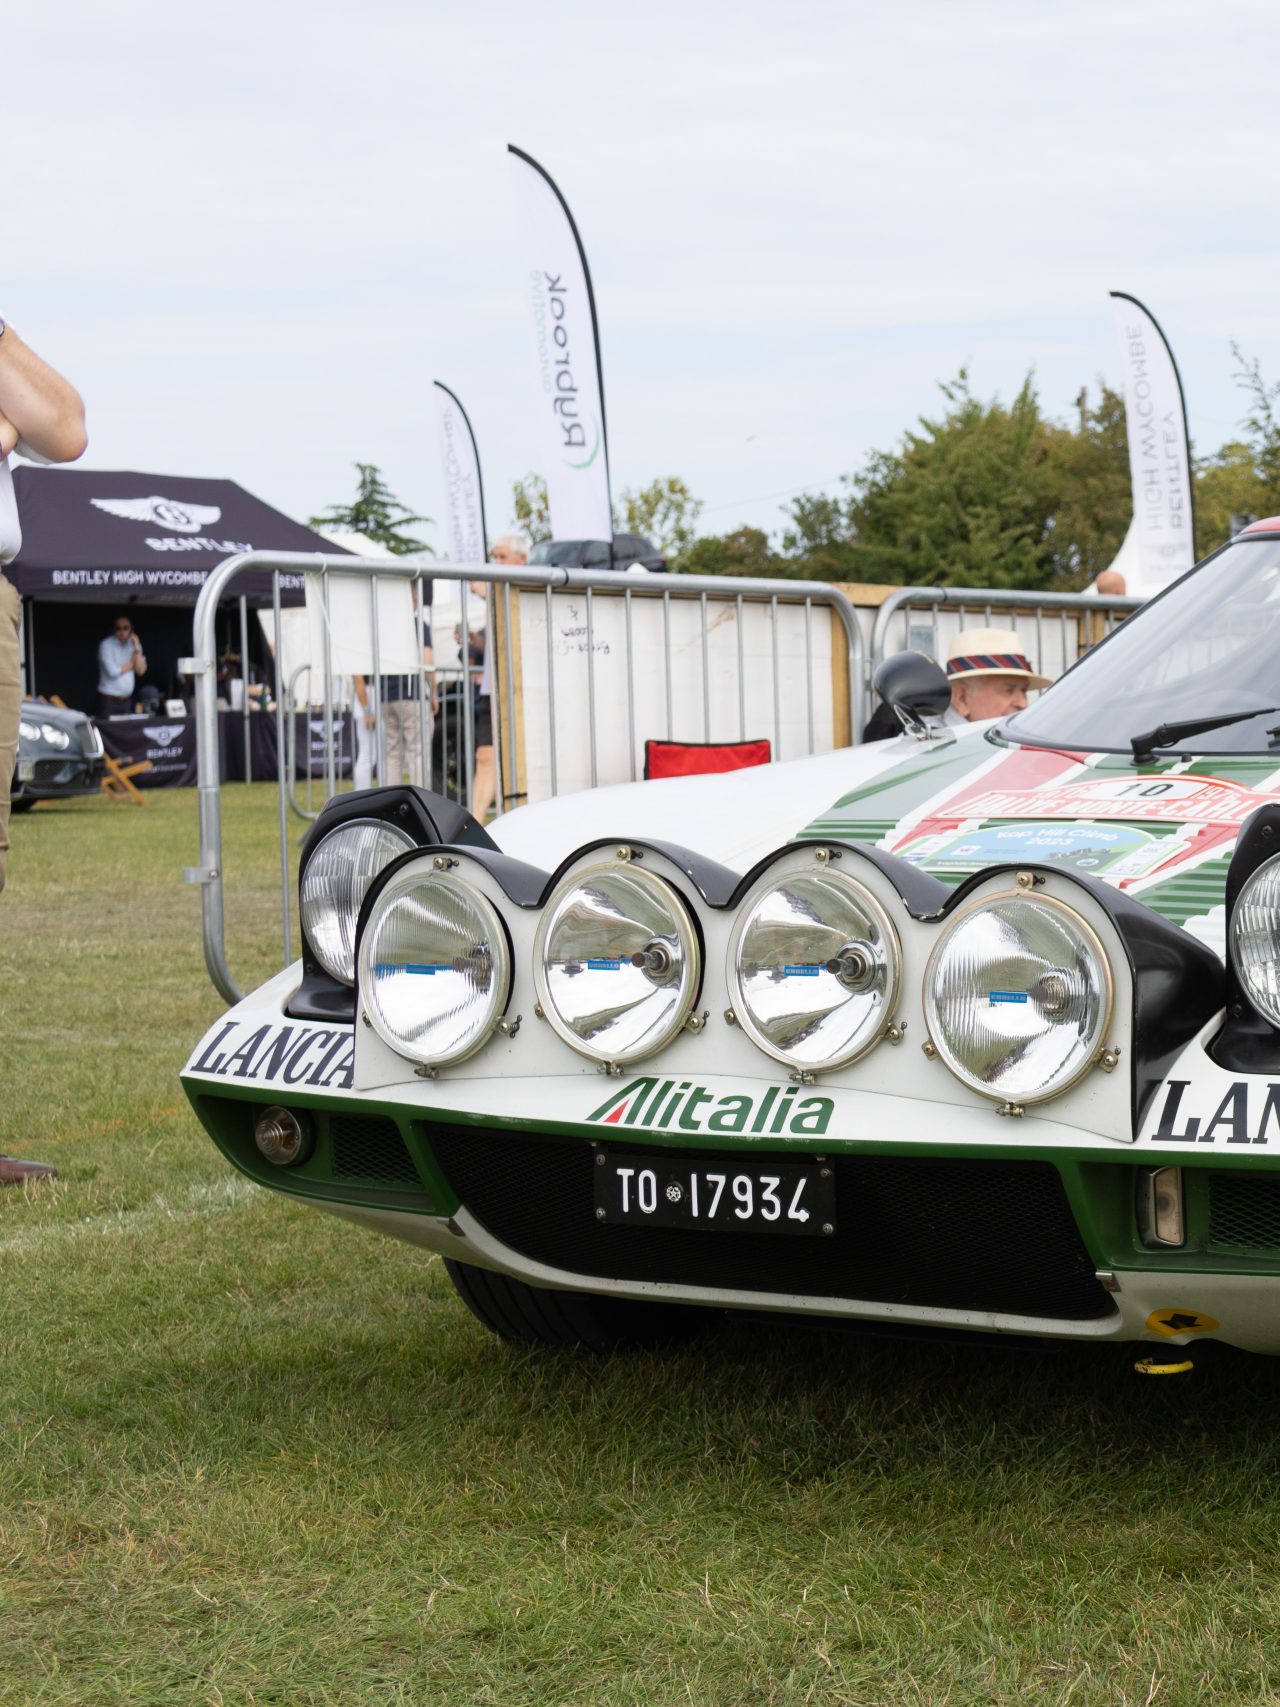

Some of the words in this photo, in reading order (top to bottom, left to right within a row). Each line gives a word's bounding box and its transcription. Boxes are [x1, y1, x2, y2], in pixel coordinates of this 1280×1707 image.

[145, 538, 252, 554] BENTLEY
[52, 570, 110, 585] BENTLEY
[113, 570, 144, 585] HIGH
[146, 571, 208, 585] WYCOMBE
[279, 574, 305, 589] BENT
[1115, 783, 1174, 797] 10
[1024, 837, 1075, 846] 2023
[1068, 829, 1119, 841] Climb
[190, 1021, 354, 1089] LANCIA
[585, 1077, 835, 1134] Alitalia
[617, 1168, 657, 1214] TO
[690, 1173, 810, 1223] 17934
